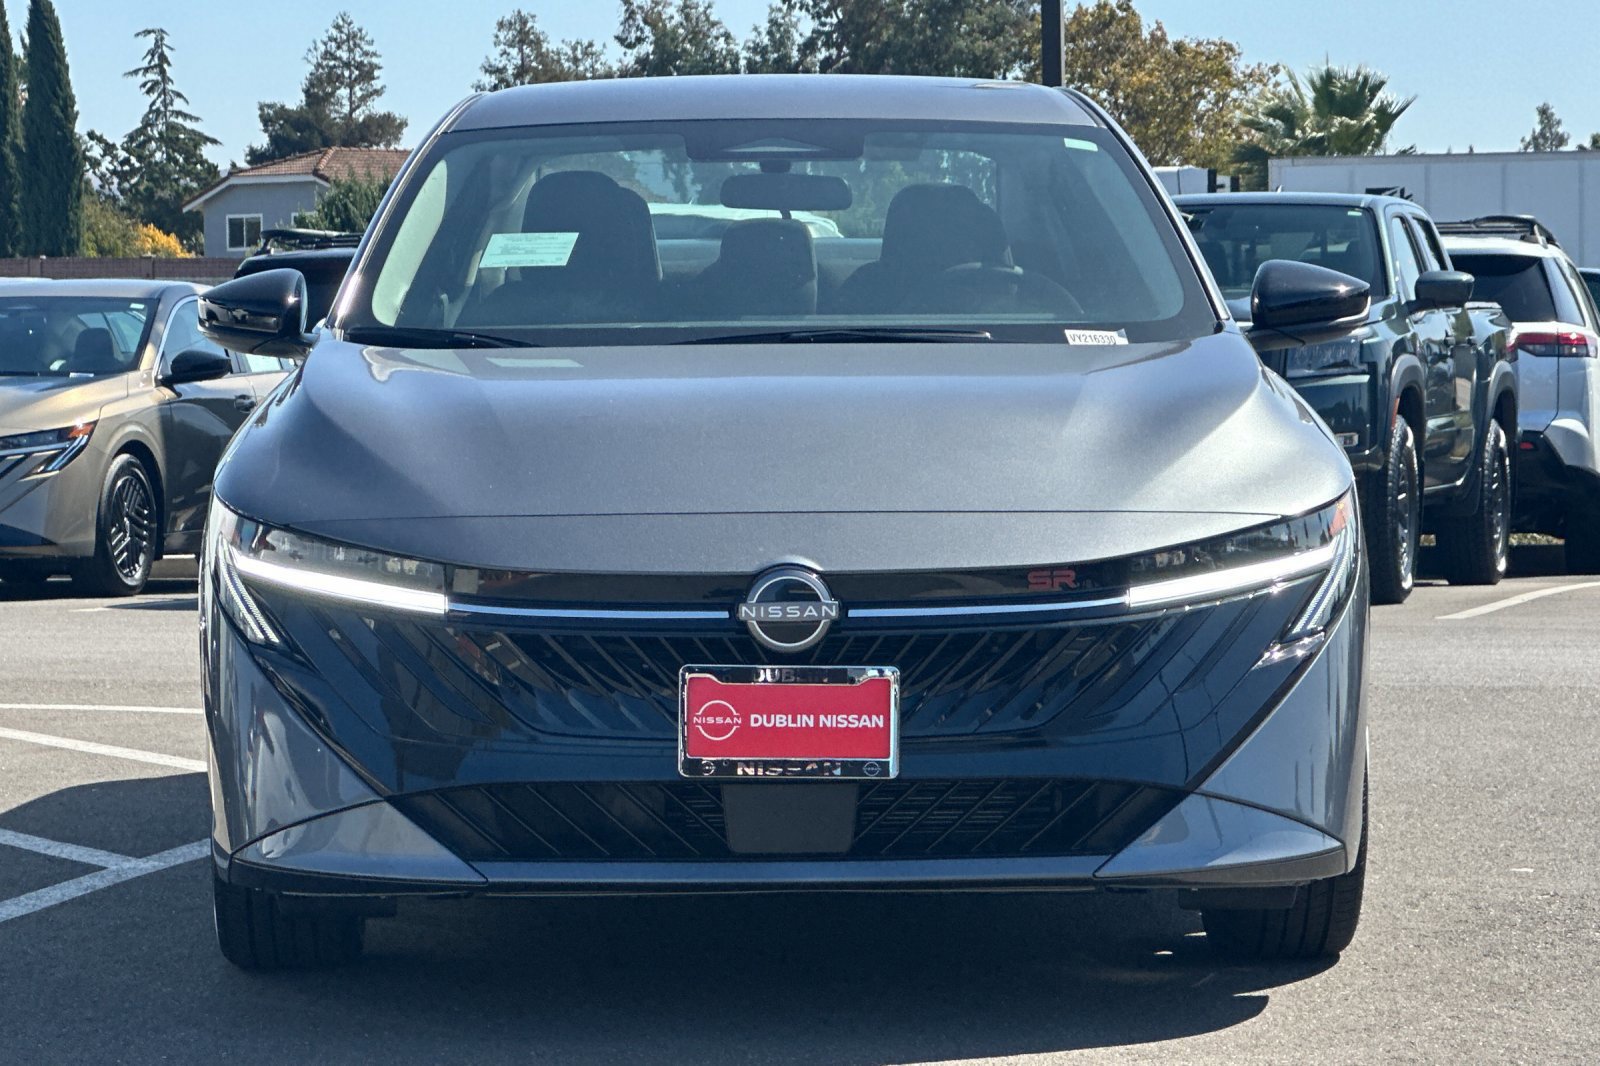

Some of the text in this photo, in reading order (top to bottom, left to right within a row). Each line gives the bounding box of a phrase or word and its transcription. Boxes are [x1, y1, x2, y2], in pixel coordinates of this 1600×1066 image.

[1027, 569, 1077, 591] SR
[741, 604, 837, 618] NISSAN
[693, 716, 742, 725] NISSAN
[750, 714, 885, 728] DUBLIN NISSAN
